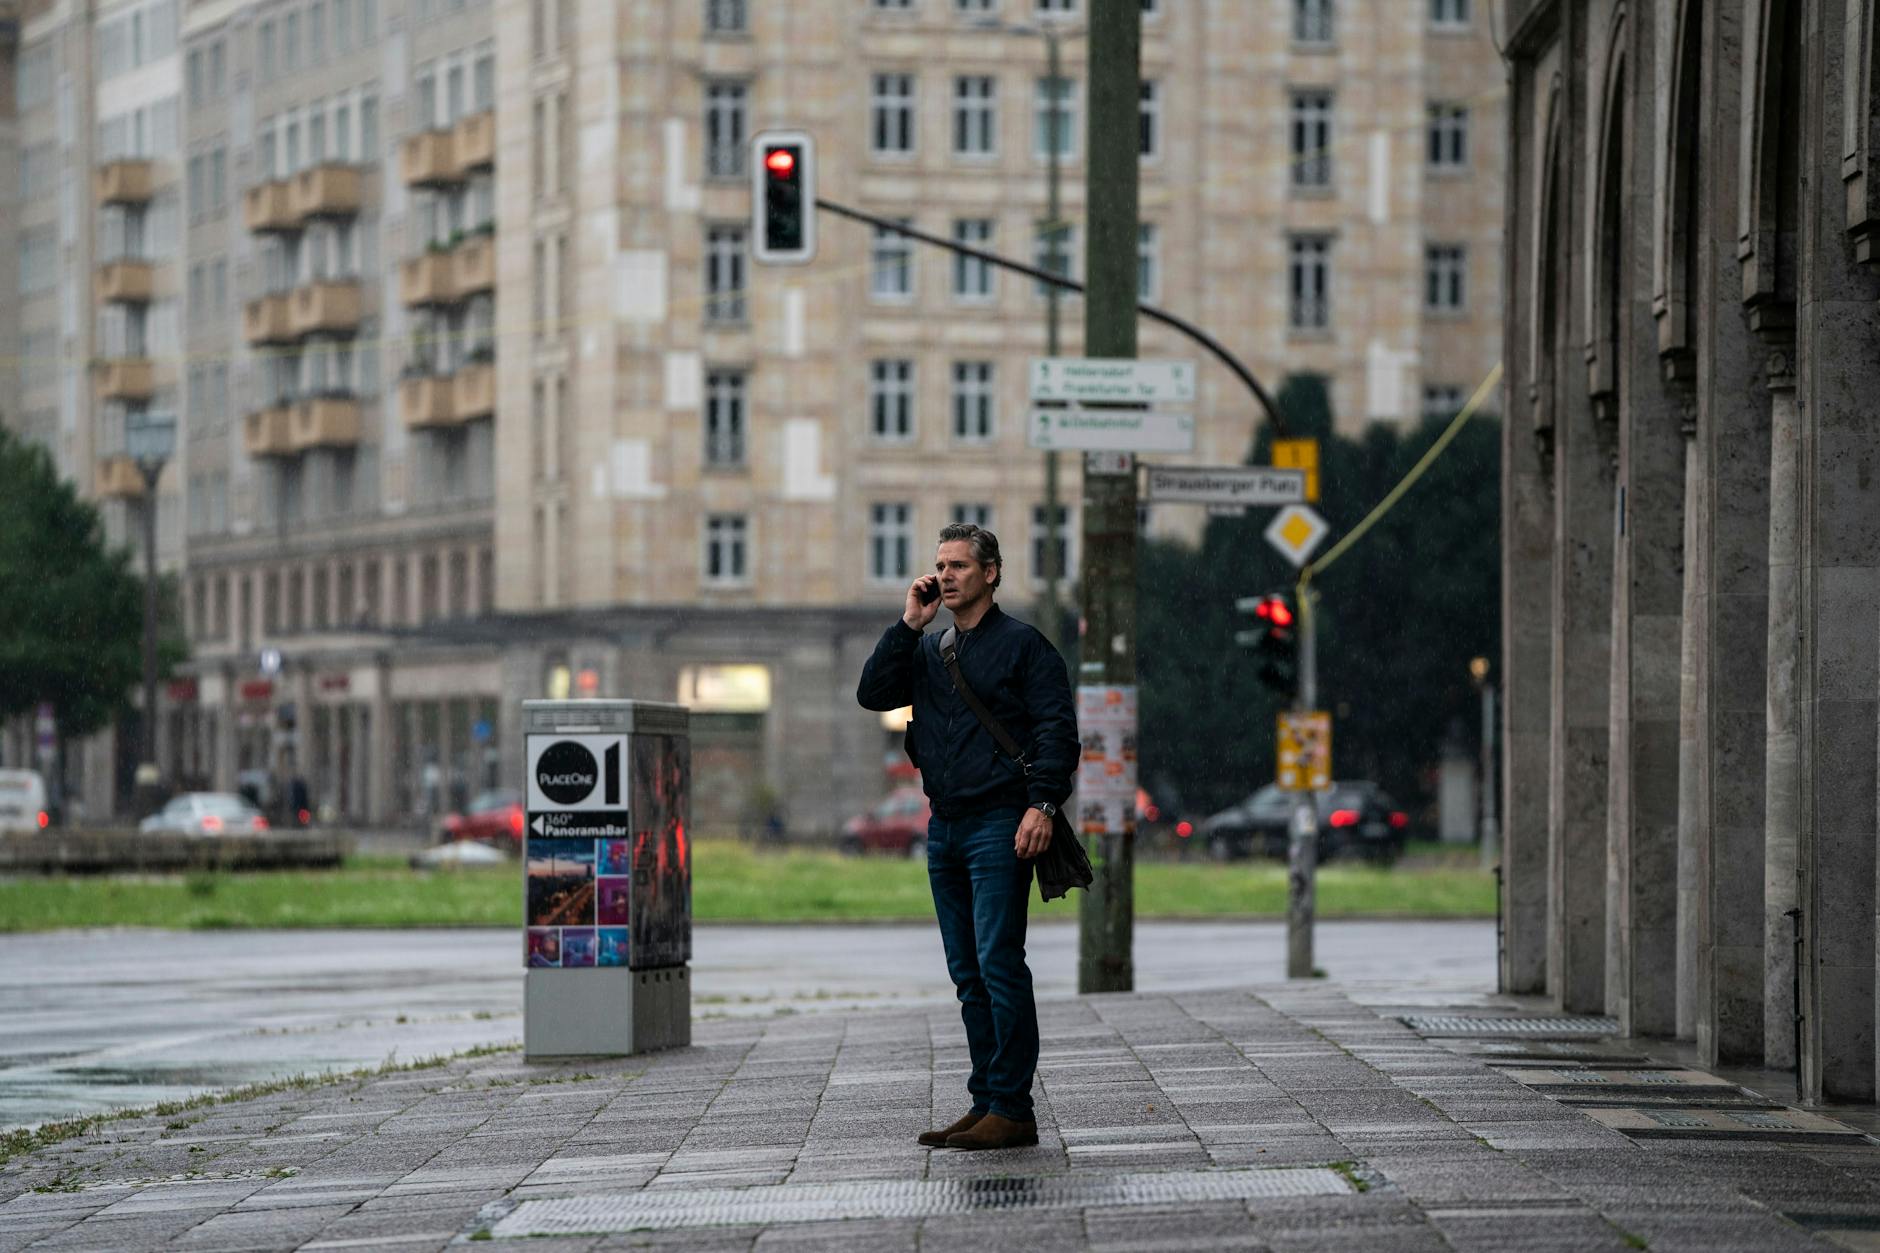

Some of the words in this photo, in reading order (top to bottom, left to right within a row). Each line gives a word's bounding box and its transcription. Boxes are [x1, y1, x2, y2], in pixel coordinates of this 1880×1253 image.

[1154, 475, 1254, 494] Strausberger
[1260, 477, 1297, 493] Platz
[545, 824, 627, 836] PanoramaBar
